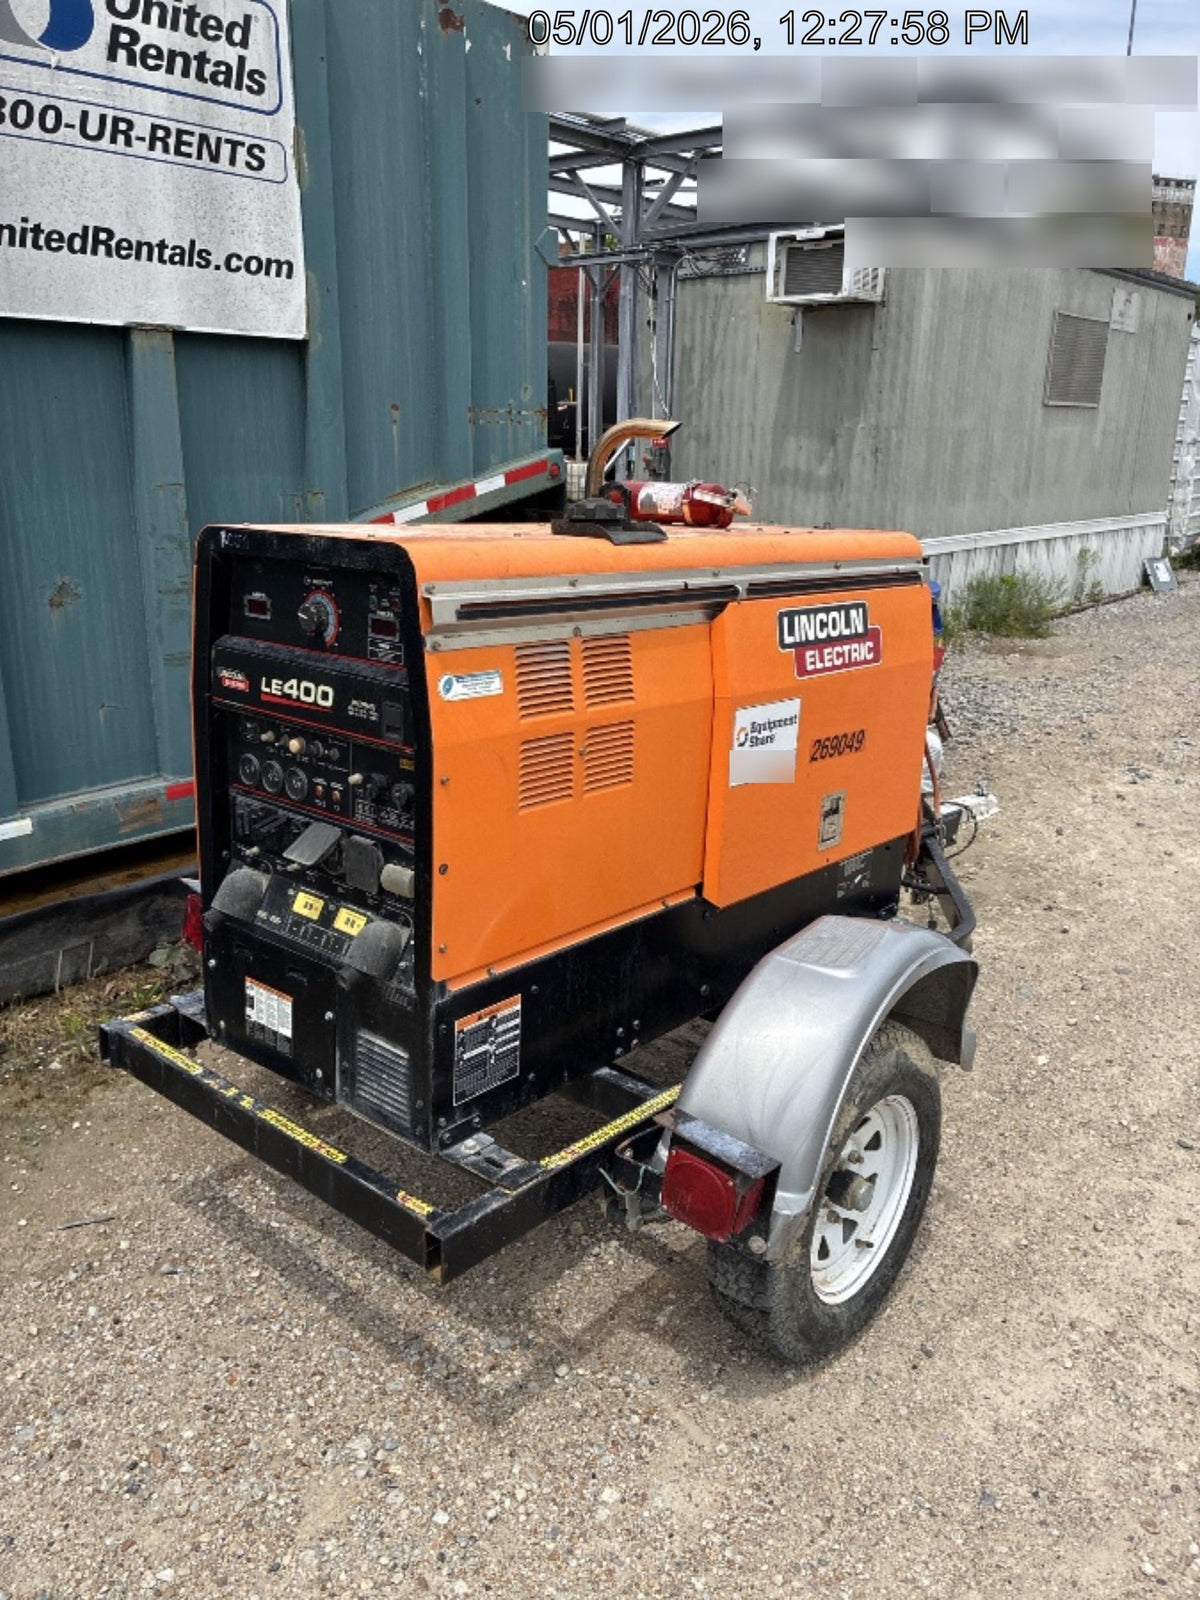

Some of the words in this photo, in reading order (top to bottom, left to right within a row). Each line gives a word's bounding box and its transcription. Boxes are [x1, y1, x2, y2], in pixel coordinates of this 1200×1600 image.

[105, 0, 253, 50] United
[105, 22, 268, 96] Rentals
[782, 606, 866, 645] LINCOLN
[805, 641, 875, 672] ELECTRIC
[260, 676, 335, 708] LE400
[808, 729, 866, 764] 269049
